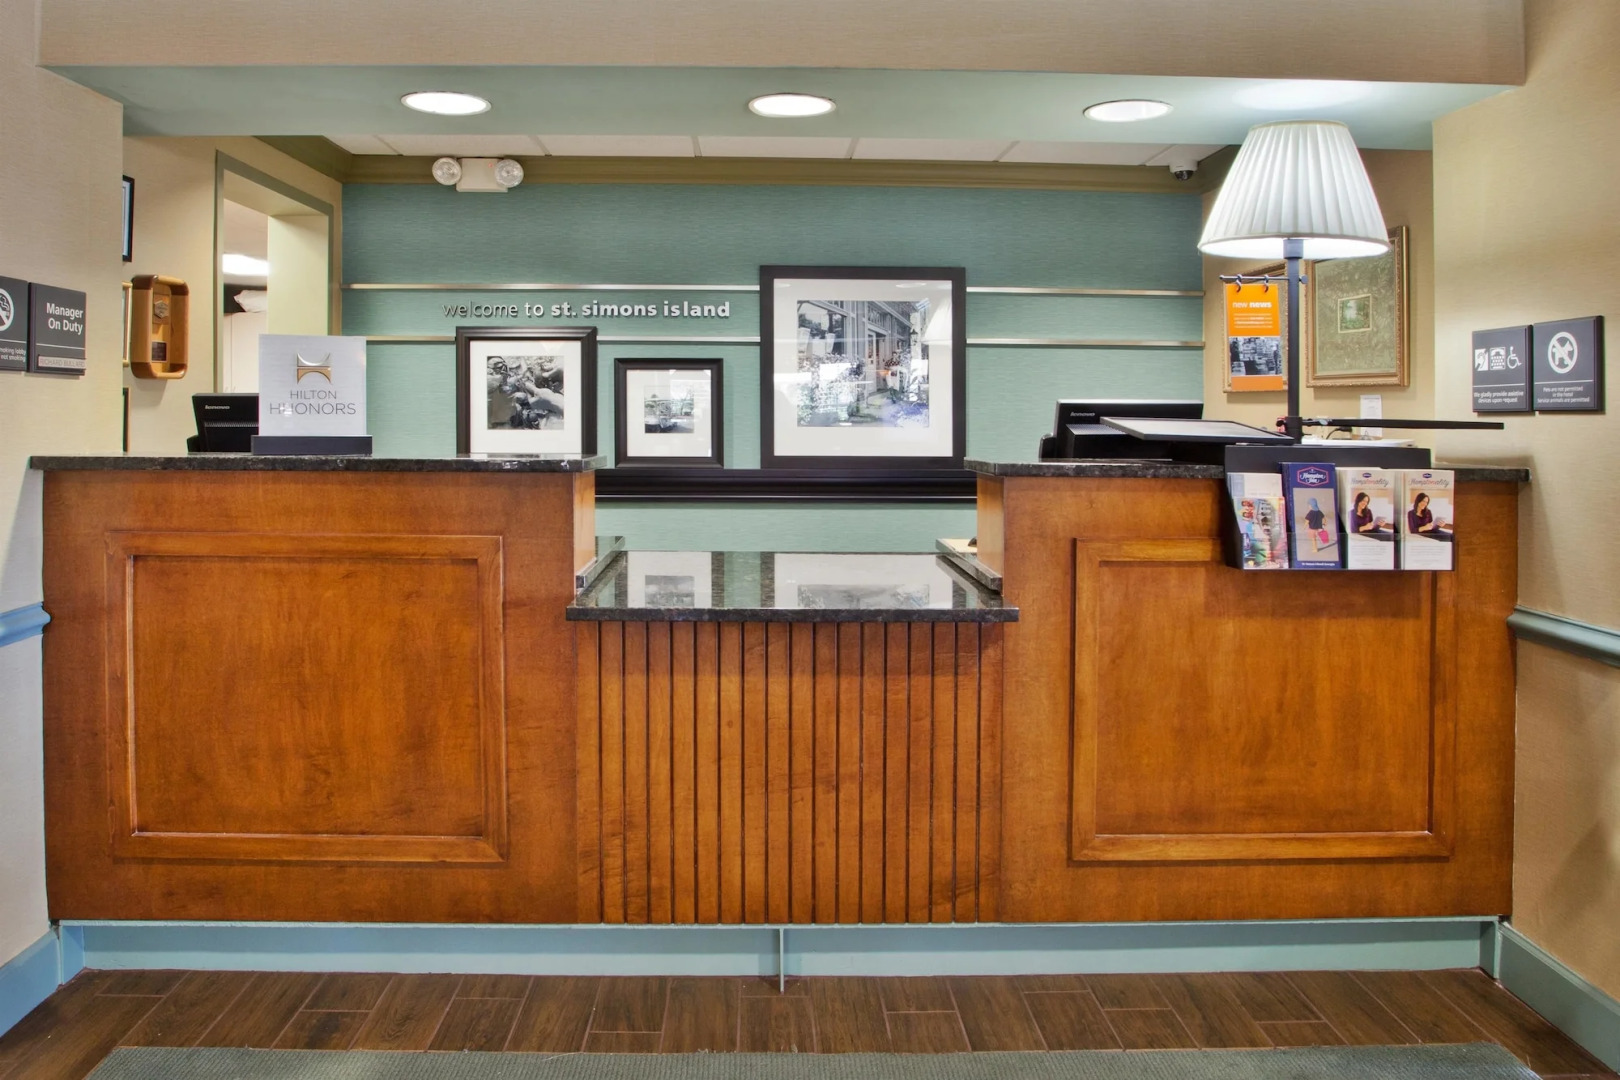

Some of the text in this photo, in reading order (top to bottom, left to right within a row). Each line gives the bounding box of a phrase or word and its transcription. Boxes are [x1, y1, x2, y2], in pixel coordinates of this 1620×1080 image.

[46, 302, 84, 320] Manager
[442, 301, 731, 318] welcome to st. simons island
[48, 318, 83, 335] On Duty
[0, 347, 15, 355] moking
[289, 389, 337, 400] HILTON
